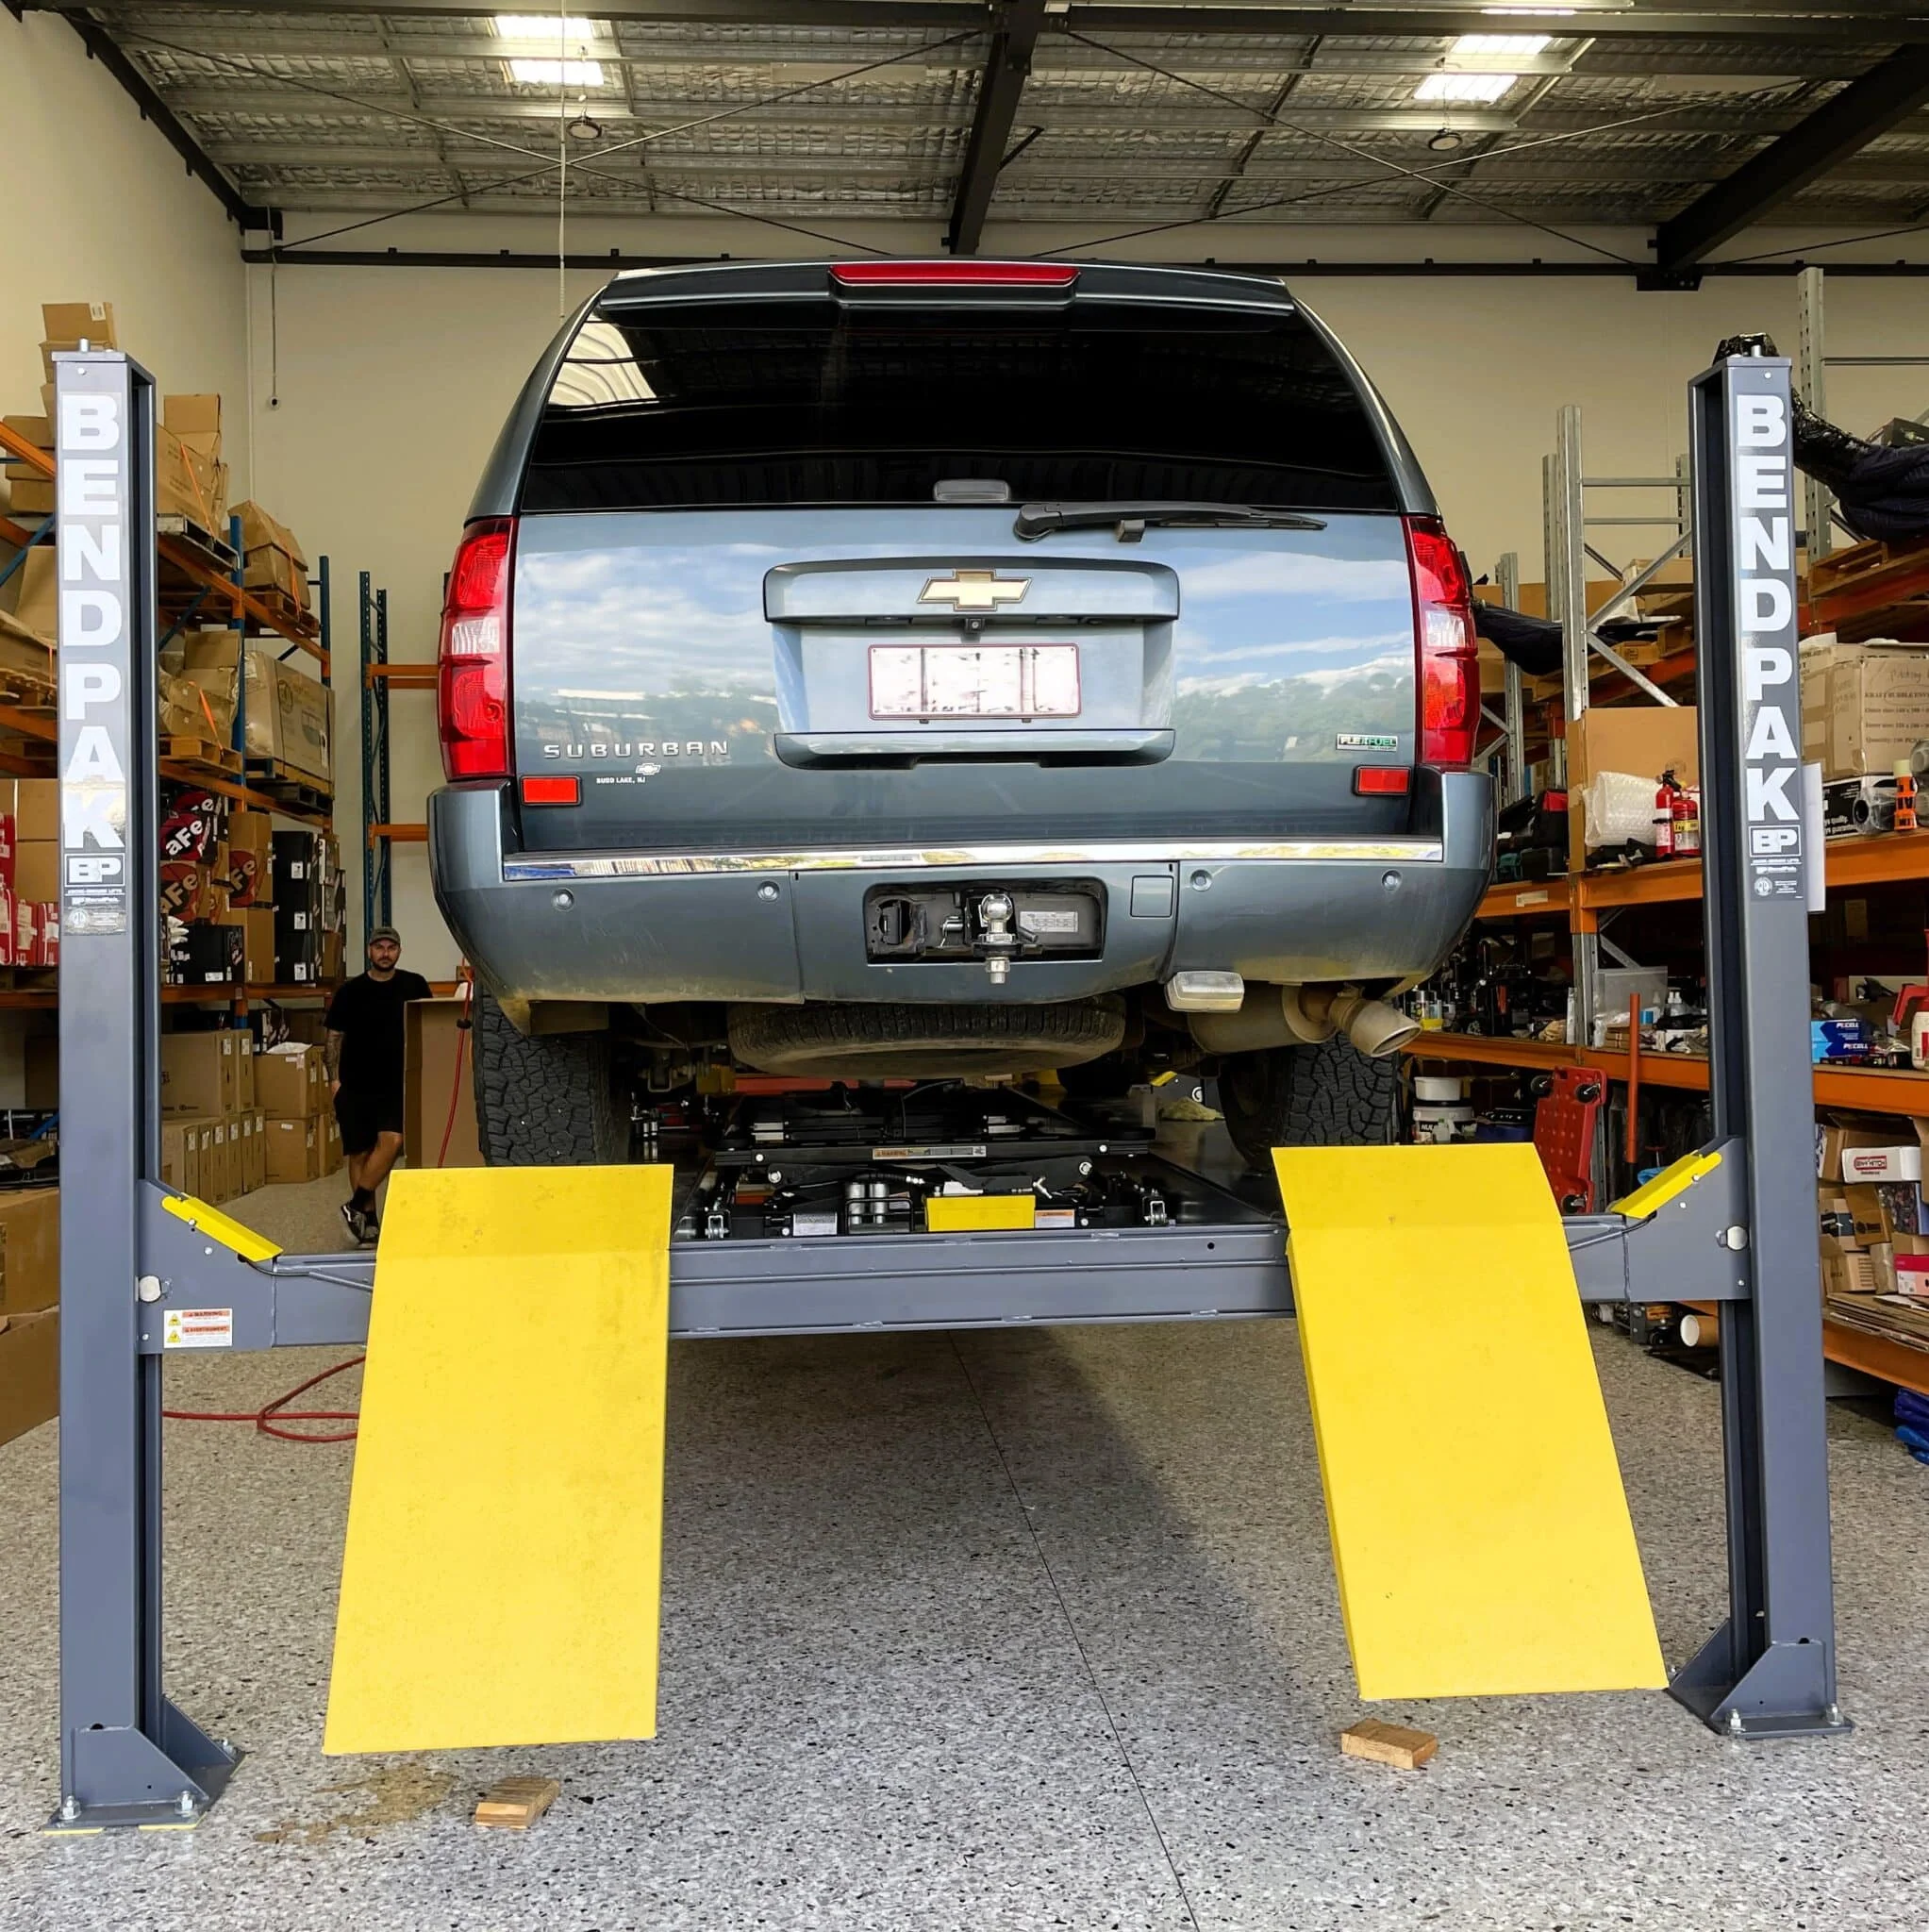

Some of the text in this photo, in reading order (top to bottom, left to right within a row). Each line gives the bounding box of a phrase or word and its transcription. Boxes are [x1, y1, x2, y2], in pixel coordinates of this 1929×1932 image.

[60, 393, 125, 849] BENDPAK
[1736, 394, 1801, 822] BENDPAK
[542, 741, 729, 758] SUBURBAN
[165, 819, 204, 857] aFe
[1752, 828, 1798, 854] BP
[68, 857, 122, 883] BP
